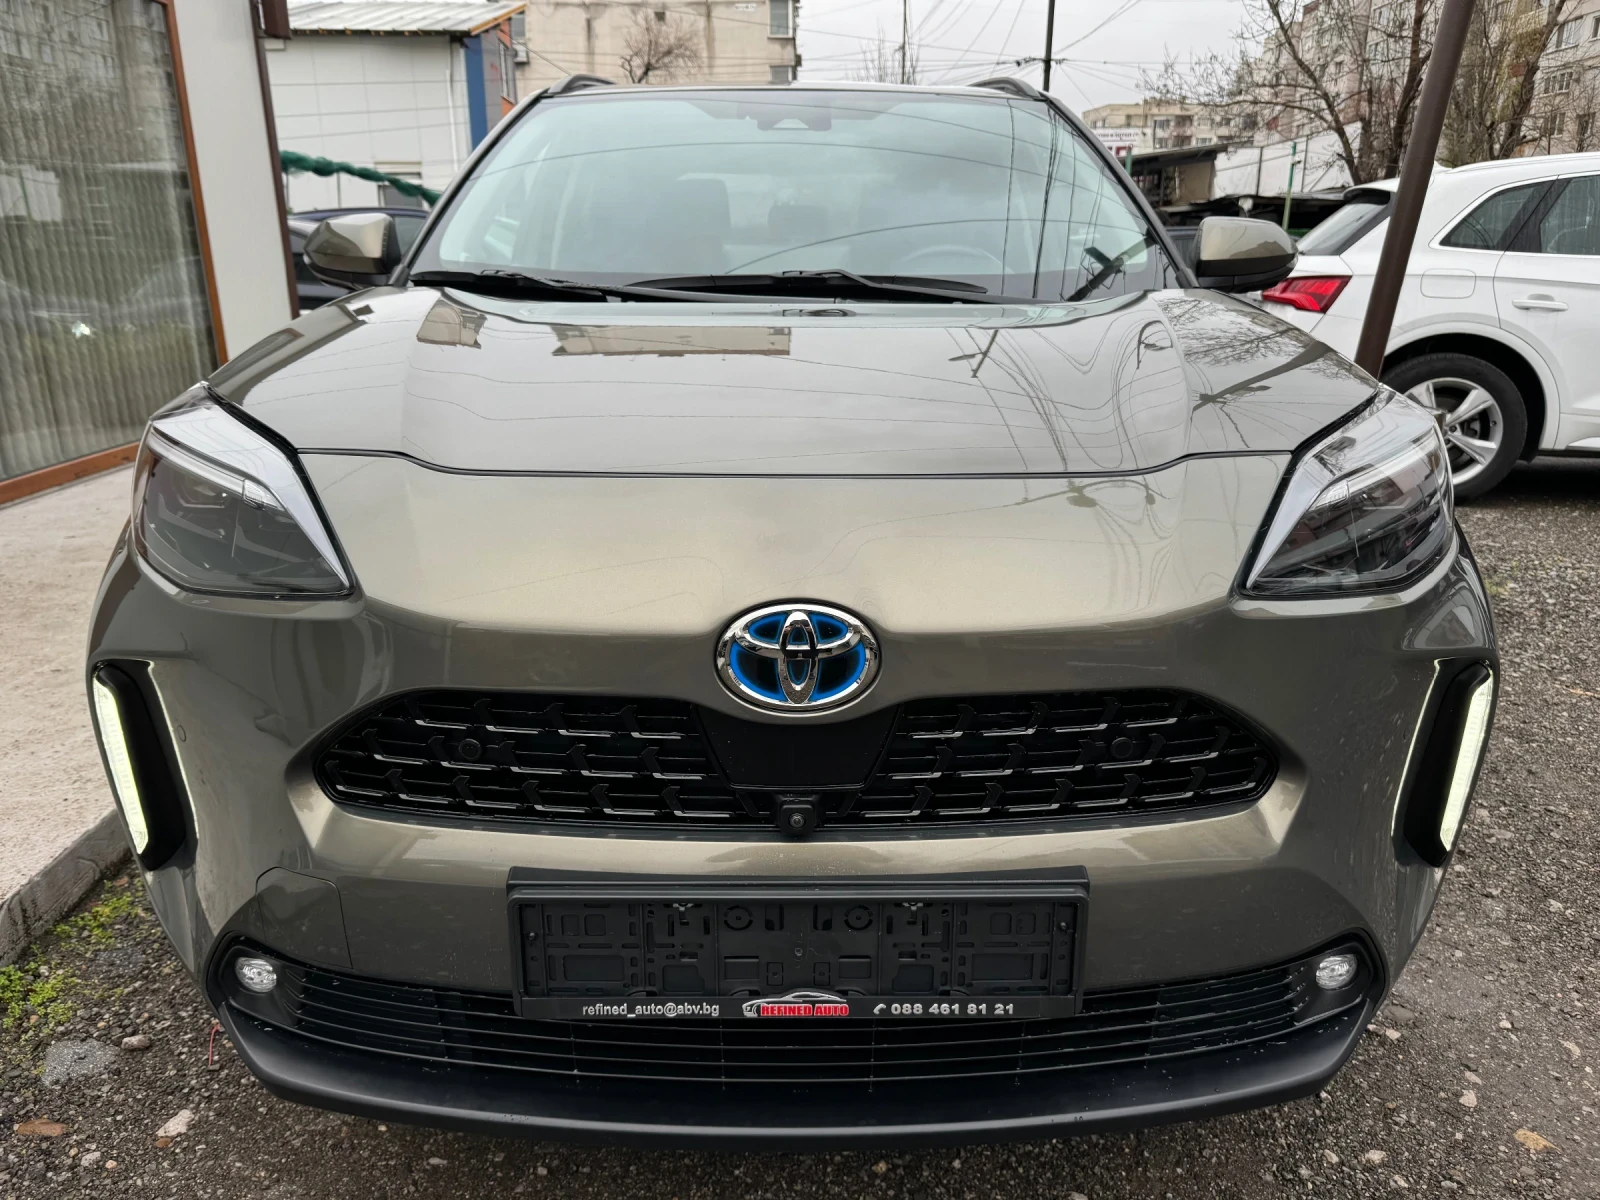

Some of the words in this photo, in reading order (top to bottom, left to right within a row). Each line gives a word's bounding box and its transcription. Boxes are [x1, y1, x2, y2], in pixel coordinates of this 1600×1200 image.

[582, 1002, 720, 1017] refined_auto@abv.bg
[760, 1004, 813, 1017] REFINED
[814, 1004, 850, 1017] AUTO
[890, 1003, 924, 1015] 088
[928, 1003, 960, 1015] 461
[966, 1003, 987, 1015] 81
[993, 1003, 1014, 1015] 21
